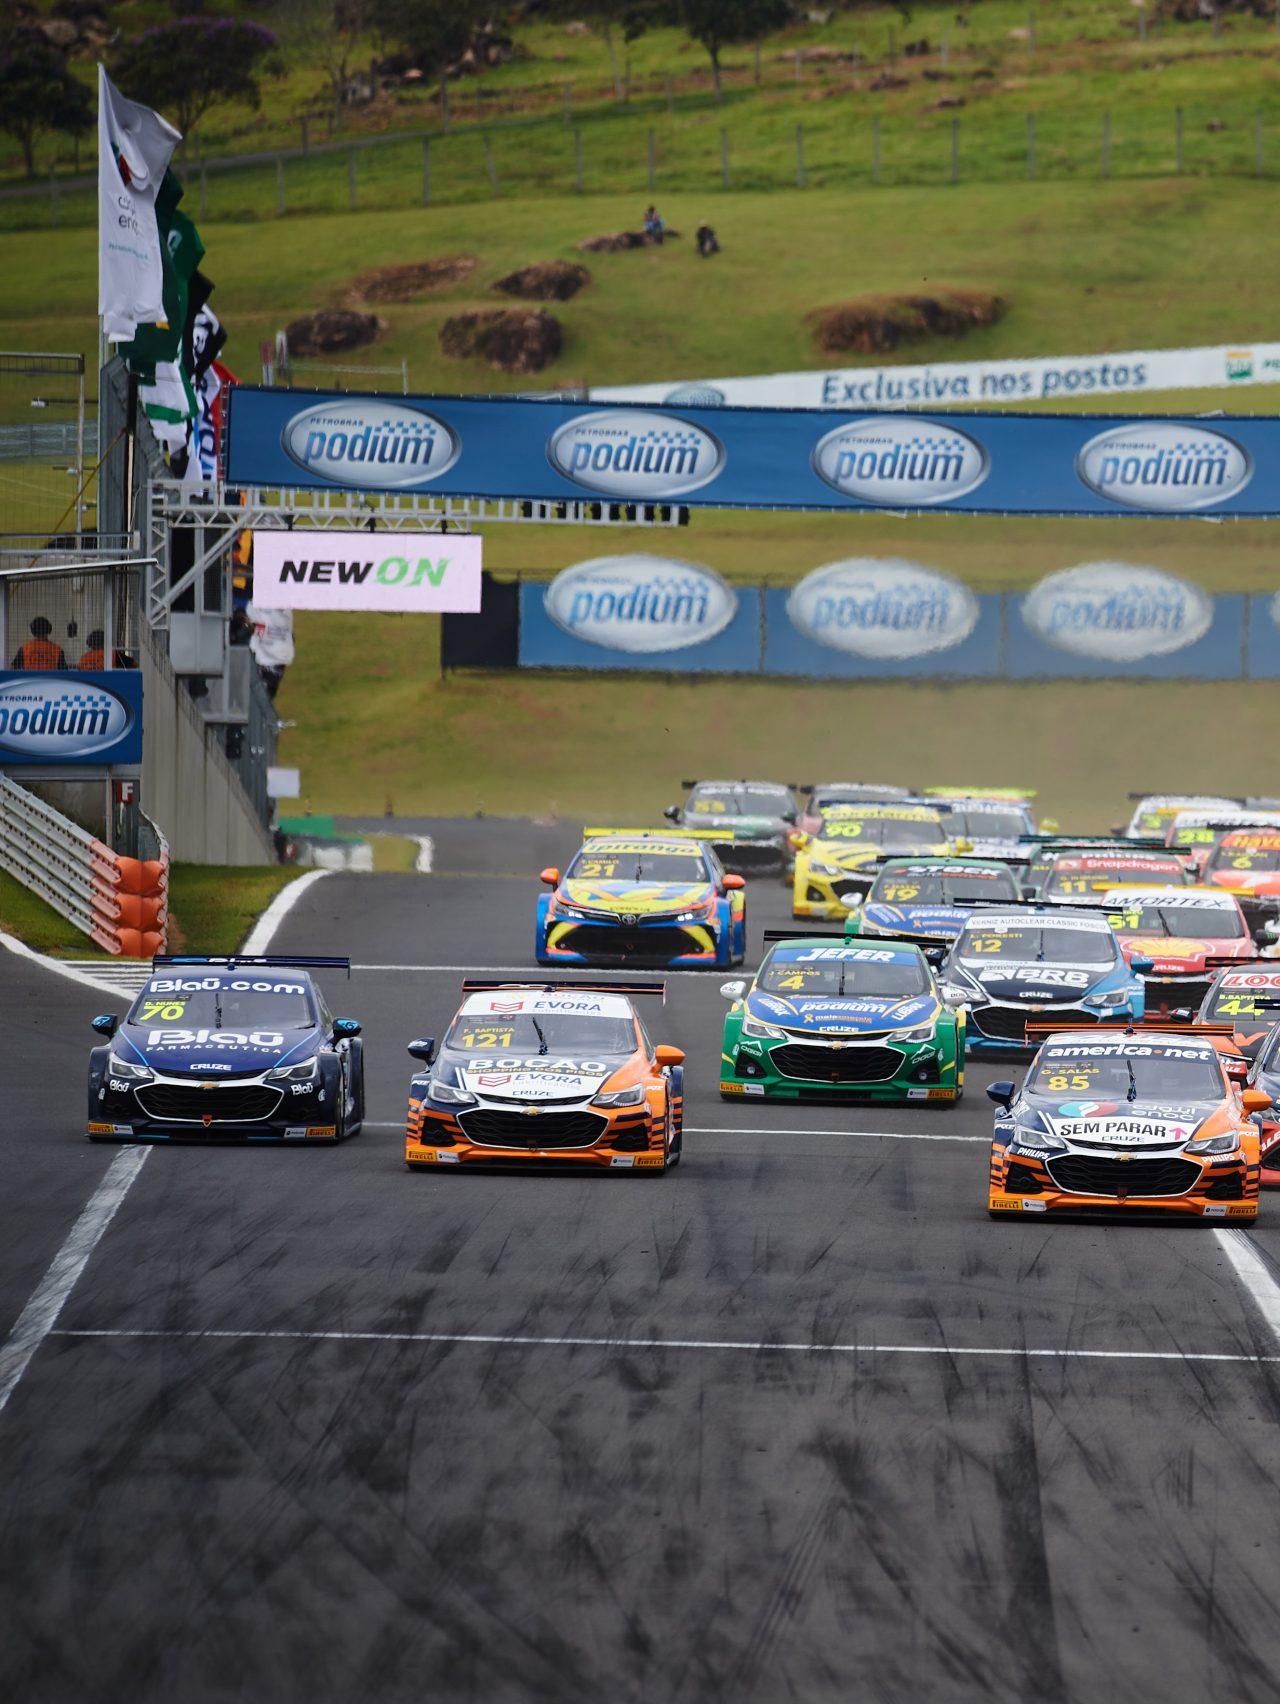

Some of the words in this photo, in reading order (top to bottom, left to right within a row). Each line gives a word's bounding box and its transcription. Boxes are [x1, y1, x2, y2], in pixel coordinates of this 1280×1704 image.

[822, 368, 970, 404] Exclusiva
[980, 371, 1031, 396] nos
[1041, 361, 1148, 398] postos
[310, 417, 365, 427] PETROBRAS
[575, 427, 630, 437] PETROBRAS
[304, 424, 436, 465] podium
[838, 436, 894, 445] PETROBRAS
[1103, 442, 1158, 450] PETROBRAS
[568, 435, 701, 476] podium
[833, 443, 965, 483] podium
[1099, 448, 1228, 487] podium
[569, 583, 711, 626] podium
[578, 864, 616, 878] 21
[1086, 859, 1181, 872] Snapdragon
[1107, 914, 1140, 930] 51
[972, 939, 1003, 954] 12
[796, 948, 896, 962] JEFER
[778, 976, 805, 990] 4
[140, 1005, 184, 1021] 70
[534, 1001, 601, 1012] EVORA
[800, 1001, 887, 1013] podium
[462, 1033, 512, 1048] 121
[190, 1063, 232, 1071] CRUZE
[514, 1073, 582, 1086] EVORA
[1048, 1075, 1091, 1091] 85
[512, 1089, 554, 1098] CRUZE
[1060, 1121, 1100, 1136] SEM
[1105, 1122, 1168, 1138] PARAR
[1017, 1146, 1050, 1160] PHILIPS
[1201, 1152, 1236, 1163] PHILIPS
